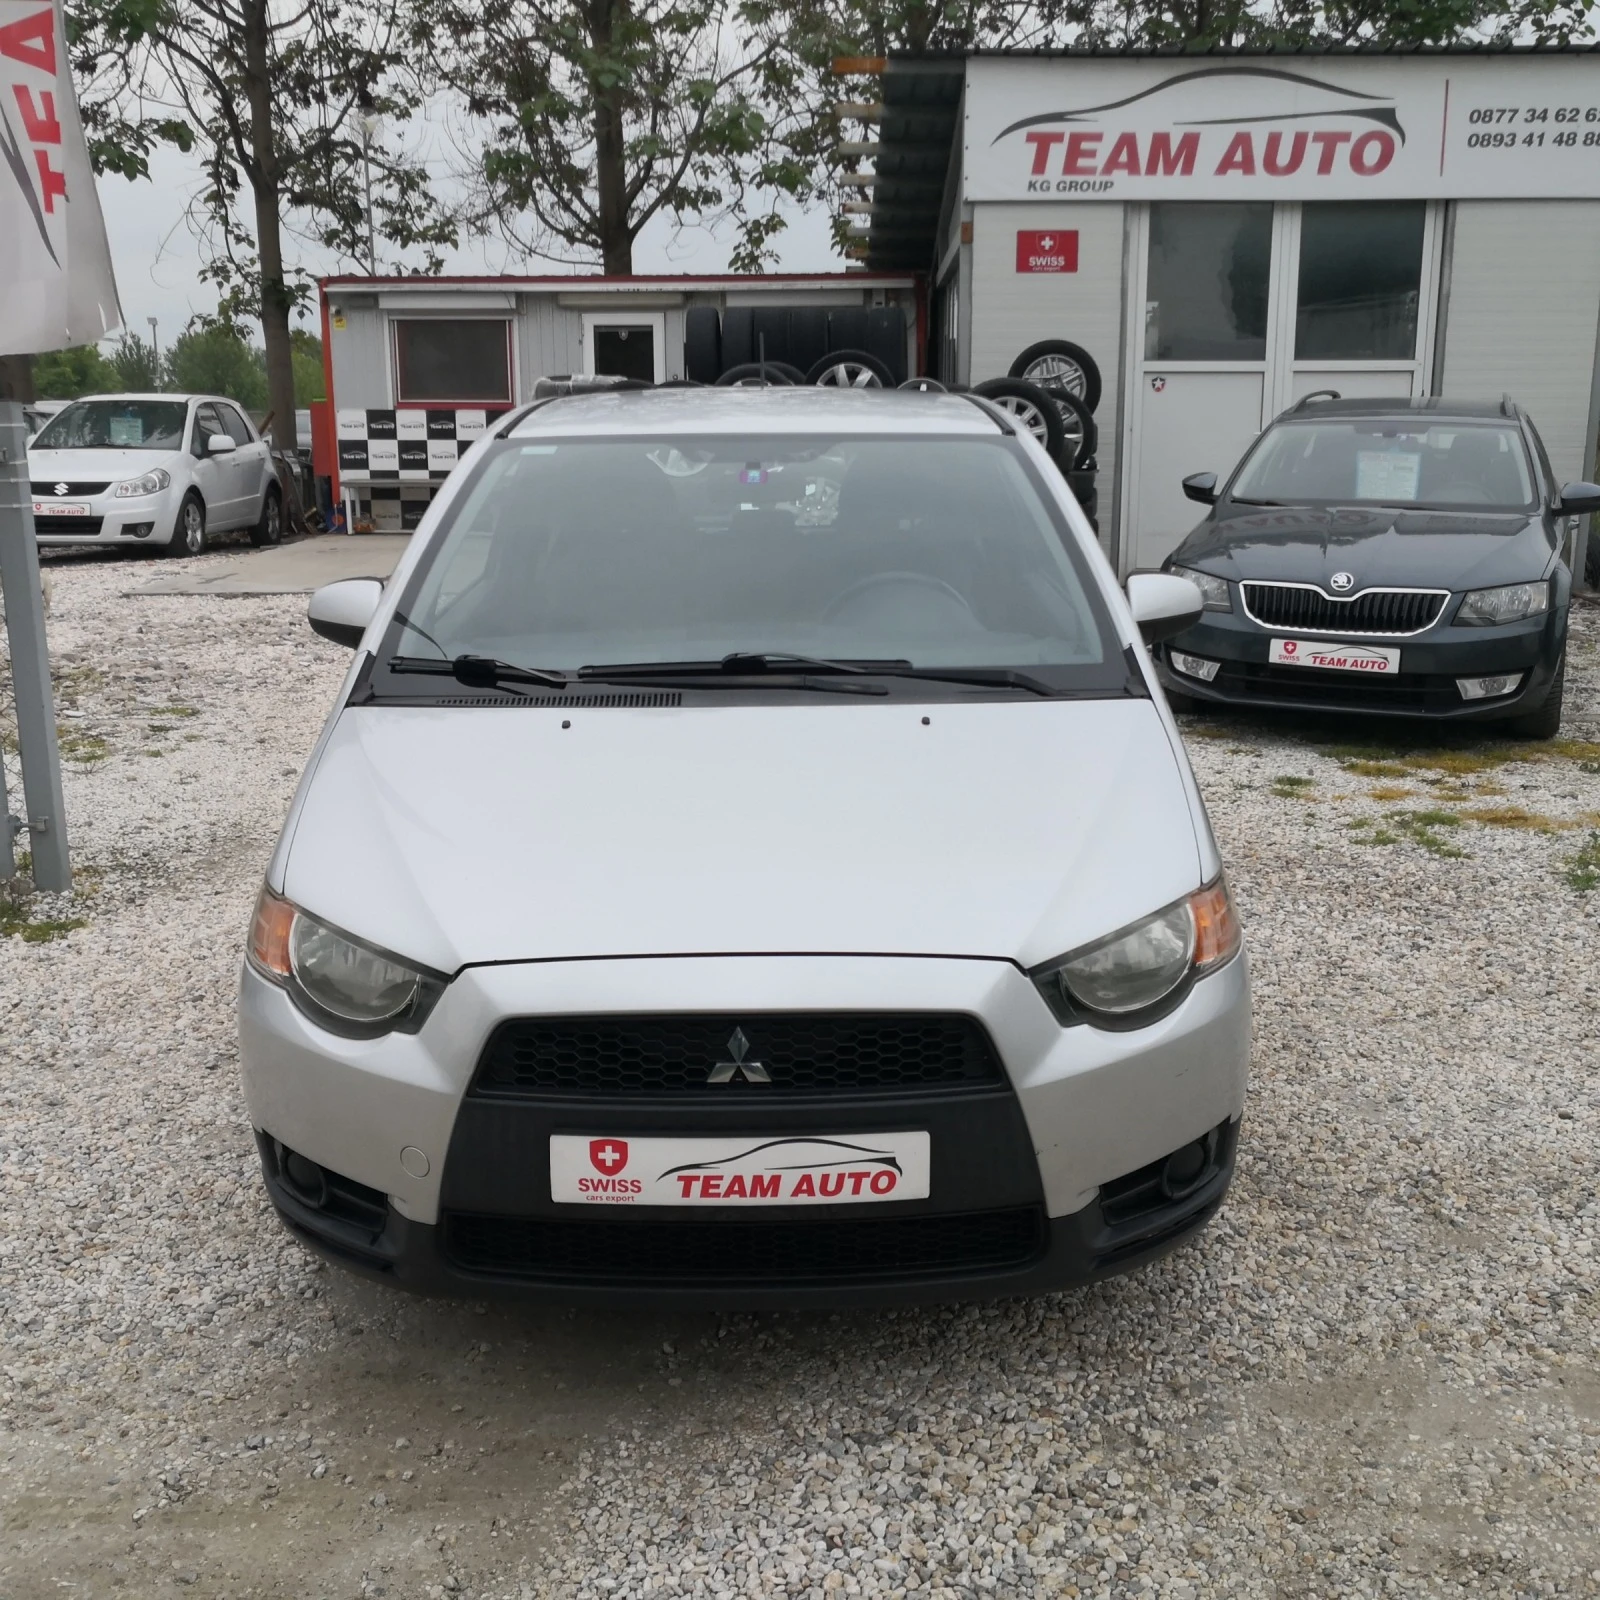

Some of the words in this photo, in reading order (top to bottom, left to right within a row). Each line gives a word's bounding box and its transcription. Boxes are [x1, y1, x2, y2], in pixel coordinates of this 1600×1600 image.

[1468, 108, 1519, 124] 0877
[1524, 108, 1548, 123] 34
[1554, 107, 1580, 123] 62
[1584, 107, 1600, 123] 6
[1467, 133, 1517, 148] 0893
[1521, 132, 1545, 147] 41
[1552, 132, 1578, 147] 48
[1025, 131, 1200, 176] TEAM
[1213, 130, 1395, 176] AUTO
[1027, 180, 1051, 193] KG
[1056, 180, 1114, 193] GROUP
[1028, 256, 1065, 267] SWISS
[1278, 654, 1300, 662] SWISS
[1311, 655, 1347, 668] TEAM
[1350, 659, 1388, 671] AUTO
[578, 1178, 642, 1194] SWISS
[677, 1175, 782, 1199] TEAM
[790, 1170, 897, 1198] AUTO
[586, 1194, 603, 1202] cars
[605, 1195, 635, 1204] export
